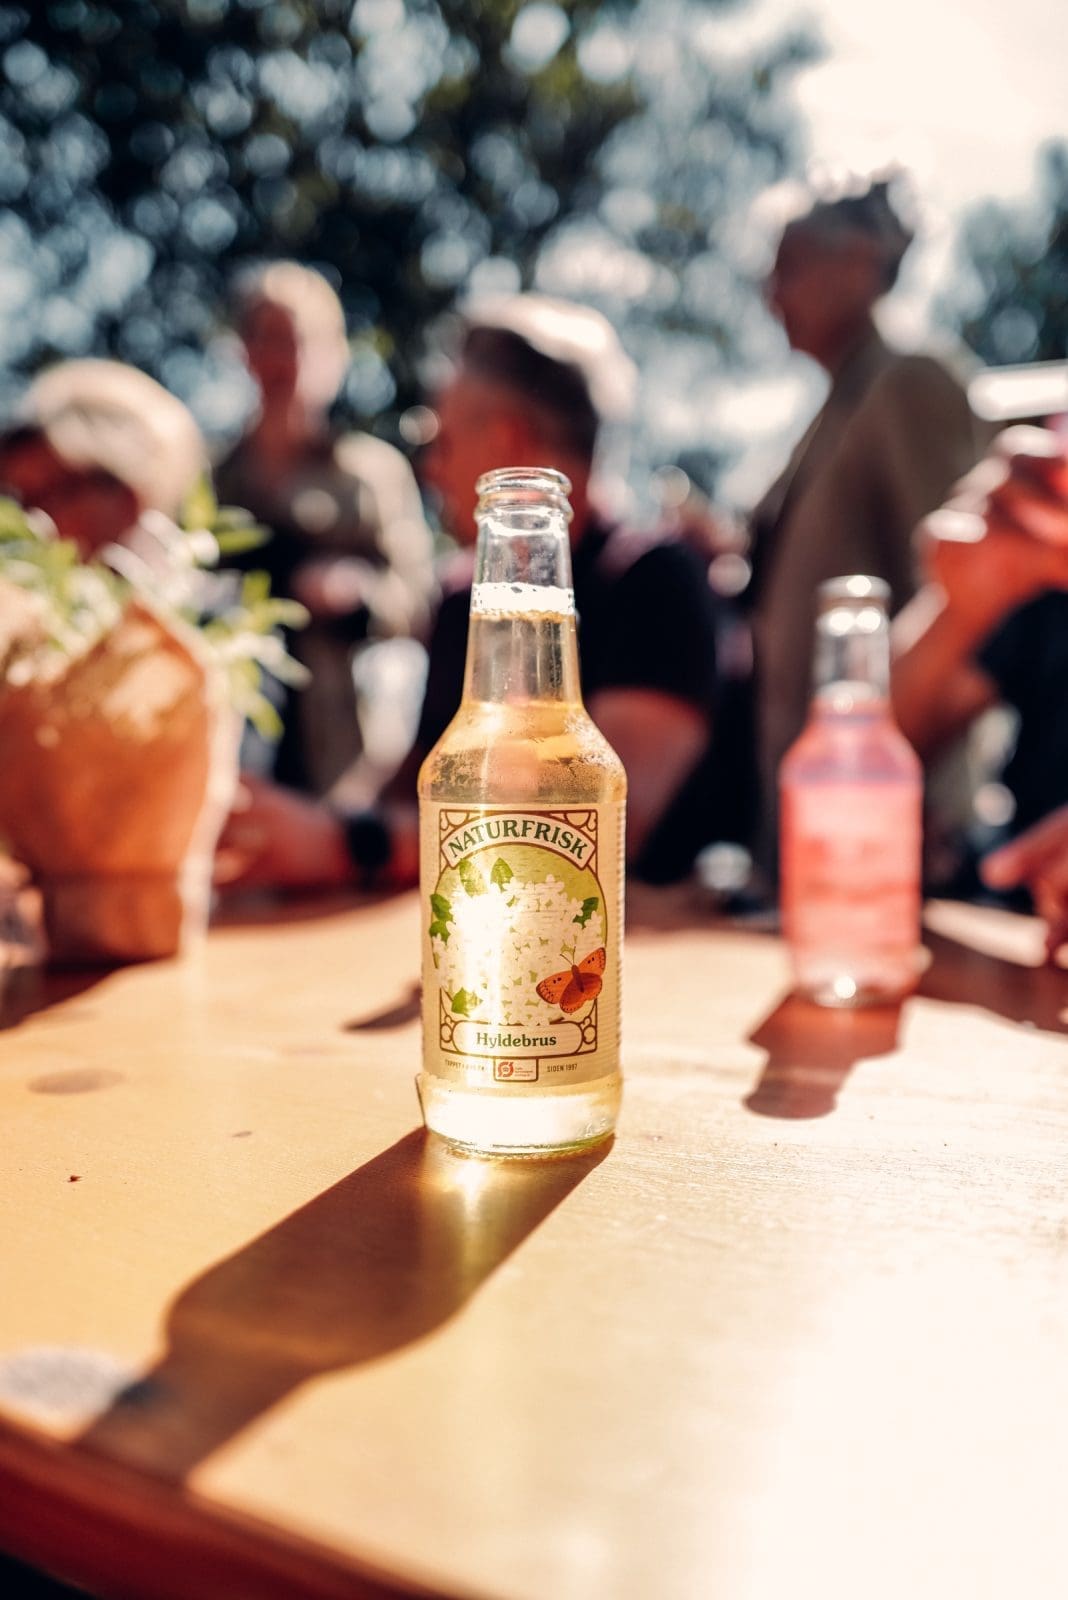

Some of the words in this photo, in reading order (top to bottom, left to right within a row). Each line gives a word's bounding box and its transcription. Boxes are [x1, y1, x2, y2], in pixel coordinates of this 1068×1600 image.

[448, 820, 588, 860] NATURFRISK
[476, 1032, 557, 1048] Hyldebrus
[547, 1064, 564, 1073] SIDEN
